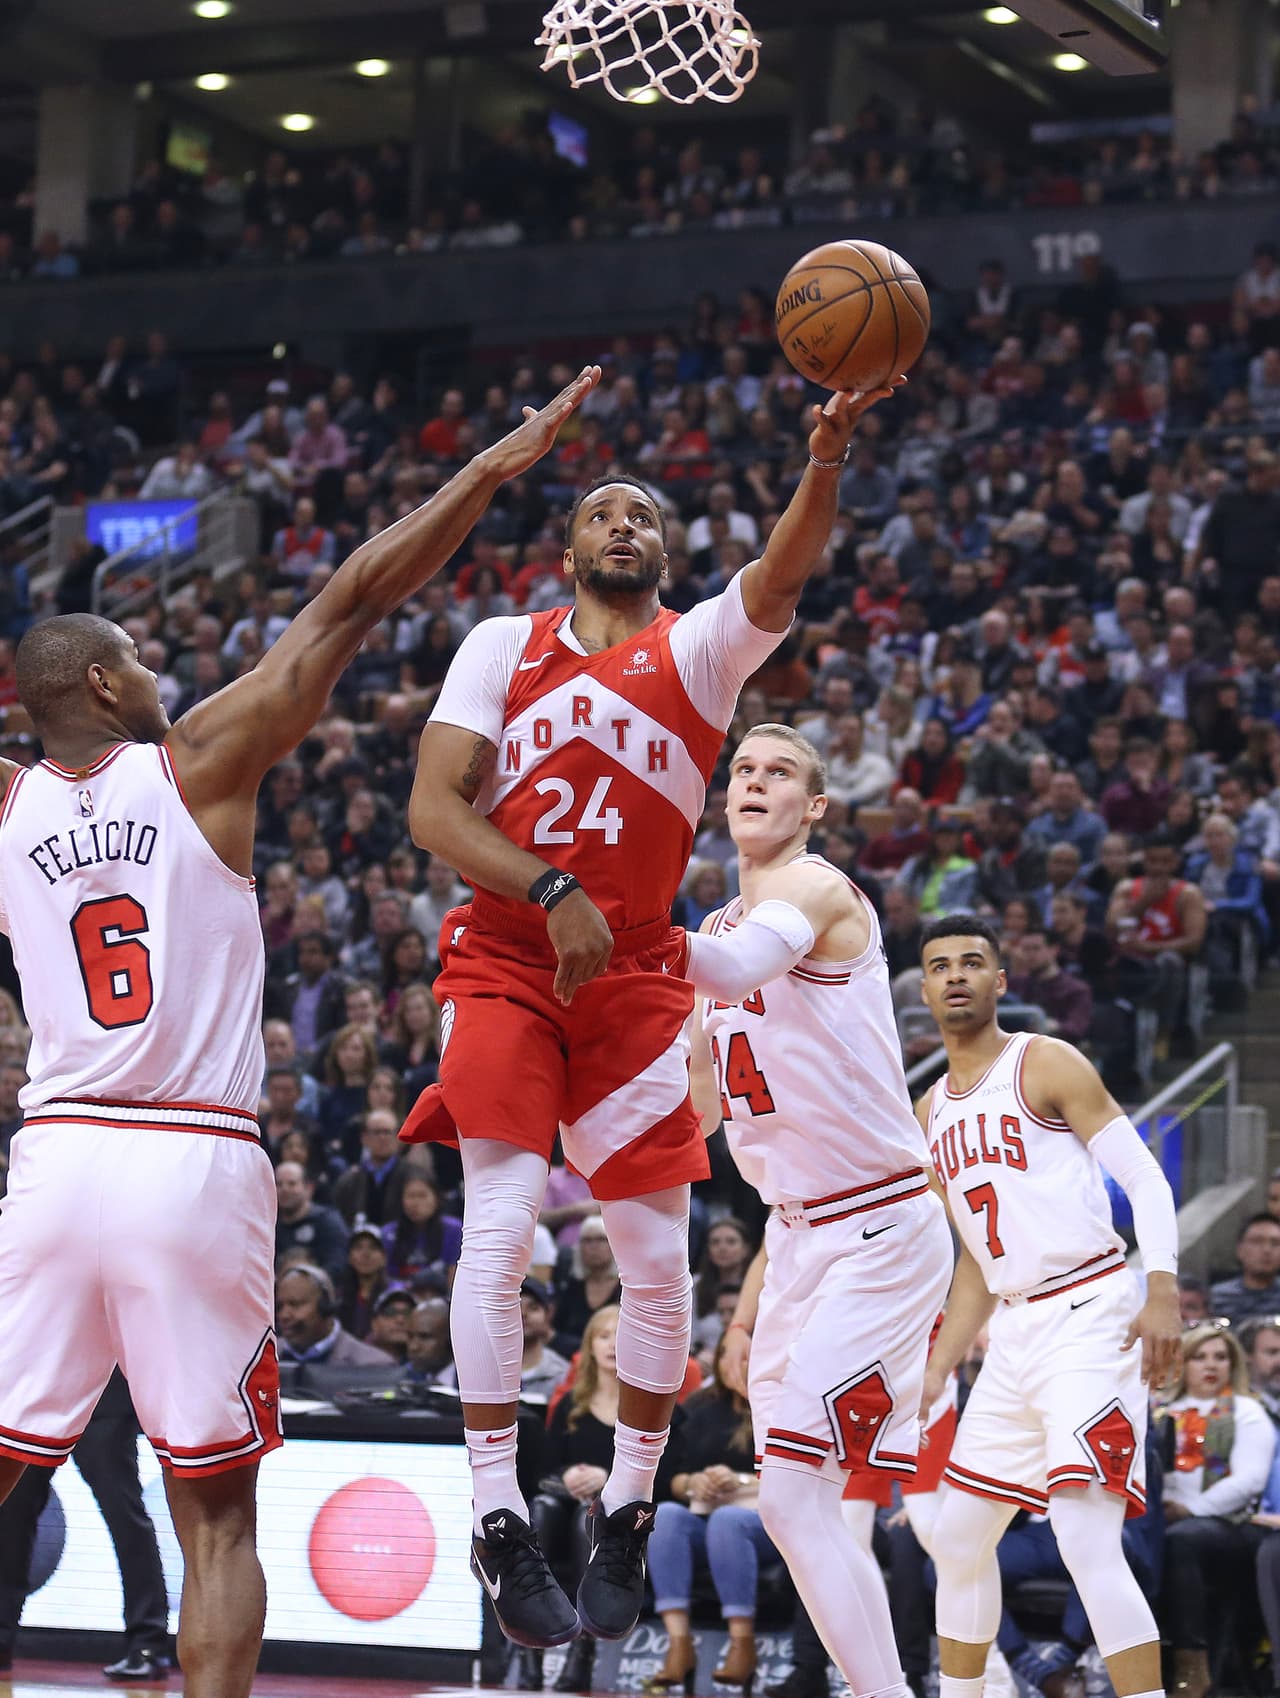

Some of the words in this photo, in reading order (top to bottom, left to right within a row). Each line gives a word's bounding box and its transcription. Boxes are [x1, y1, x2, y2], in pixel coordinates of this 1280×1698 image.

[776, 278, 822, 325] LDING
[622, 668, 640, 676] Sun
[641, 664, 657, 674] Life
[505, 695, 669, 773] NORTH
[533, 775, 623, 845] 24
[28, 820, 158, 886] FELICIO
[69, 893, 153, 1031] 6
[963, 1181, 1005, 1260] 7
